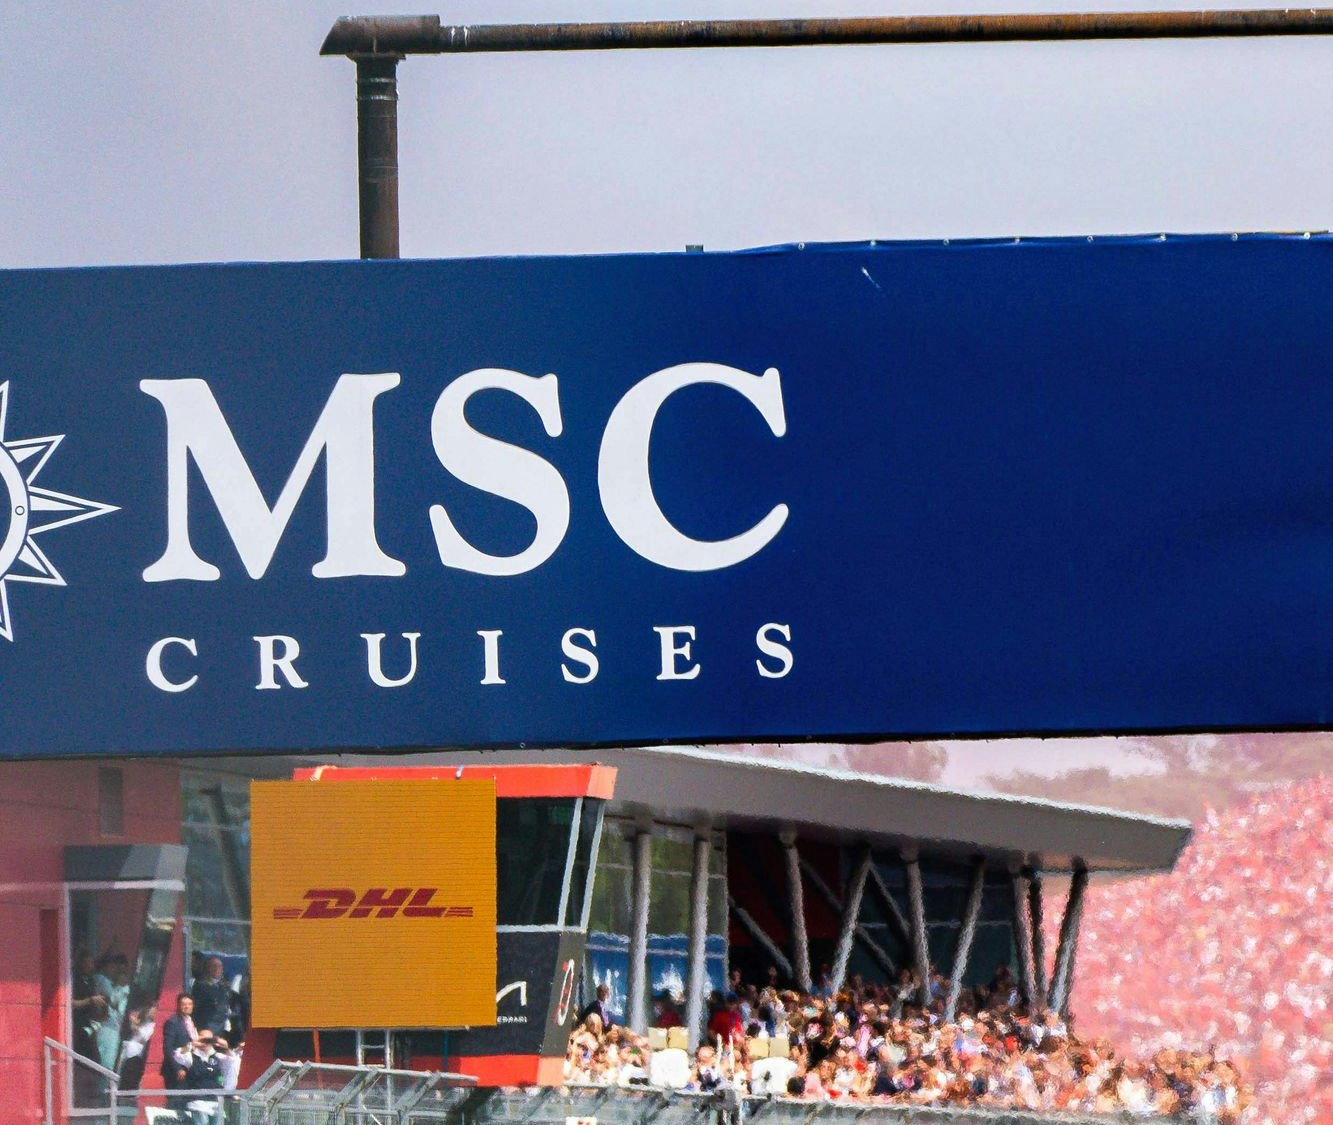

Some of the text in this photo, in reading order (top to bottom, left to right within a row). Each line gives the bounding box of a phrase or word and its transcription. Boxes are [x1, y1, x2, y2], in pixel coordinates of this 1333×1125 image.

[139, 361, 788, 583] MSC
[145, 622, 795, 693] CRUISES
[300, 887, 448, 919] DHL
